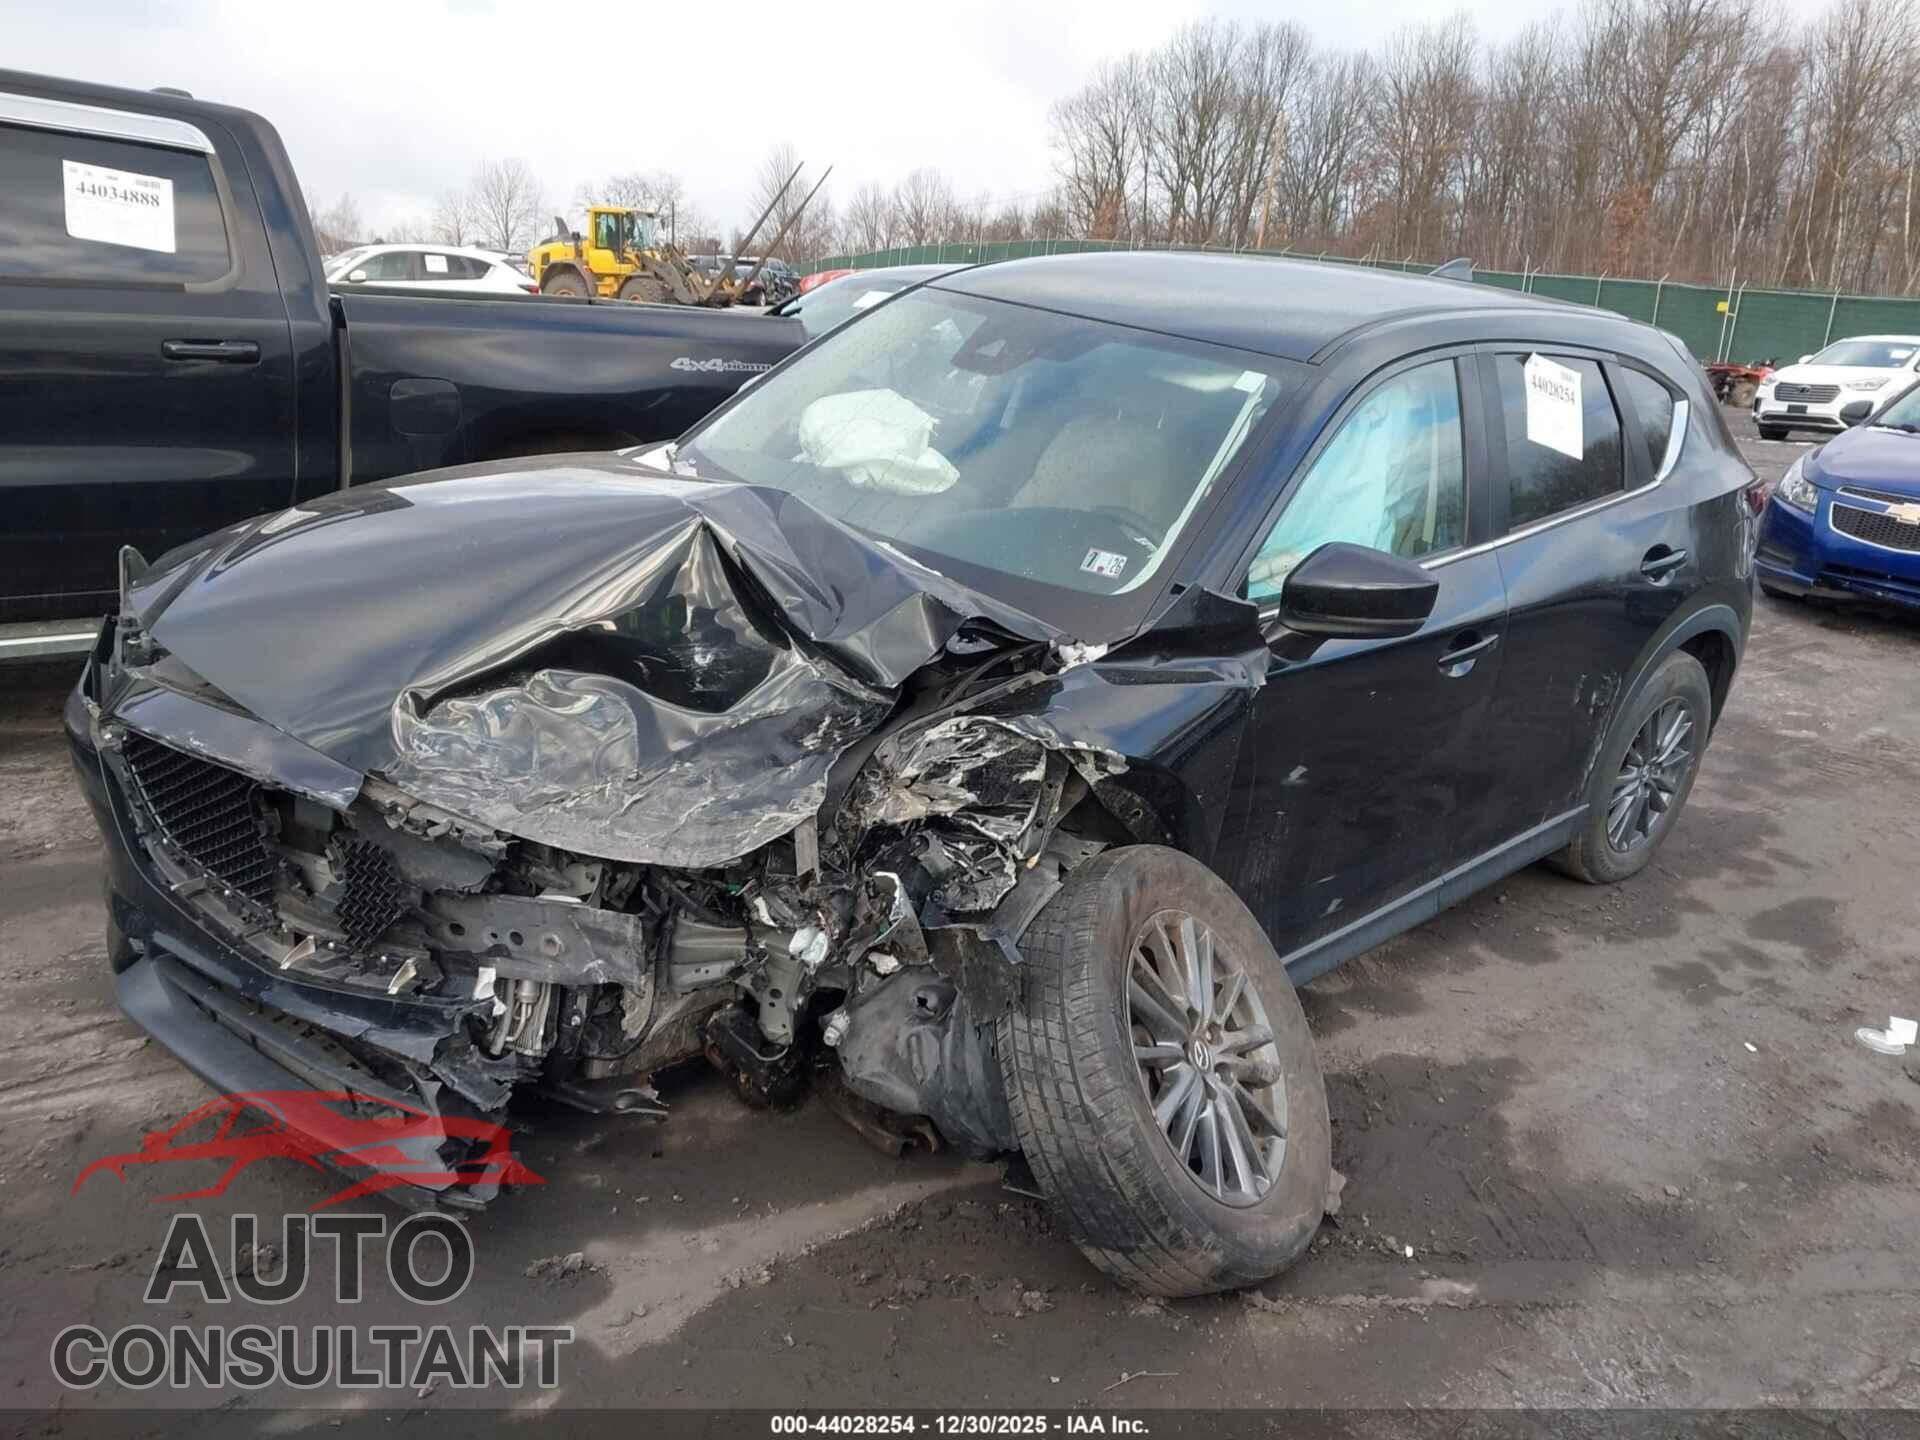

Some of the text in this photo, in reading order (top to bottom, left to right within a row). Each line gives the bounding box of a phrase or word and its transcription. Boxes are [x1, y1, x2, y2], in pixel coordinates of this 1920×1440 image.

[75, 180, 160, 208] 44034888
[670, 356, 724, 373] 4x4
[1531, 373, 1576, 406] 44028254
